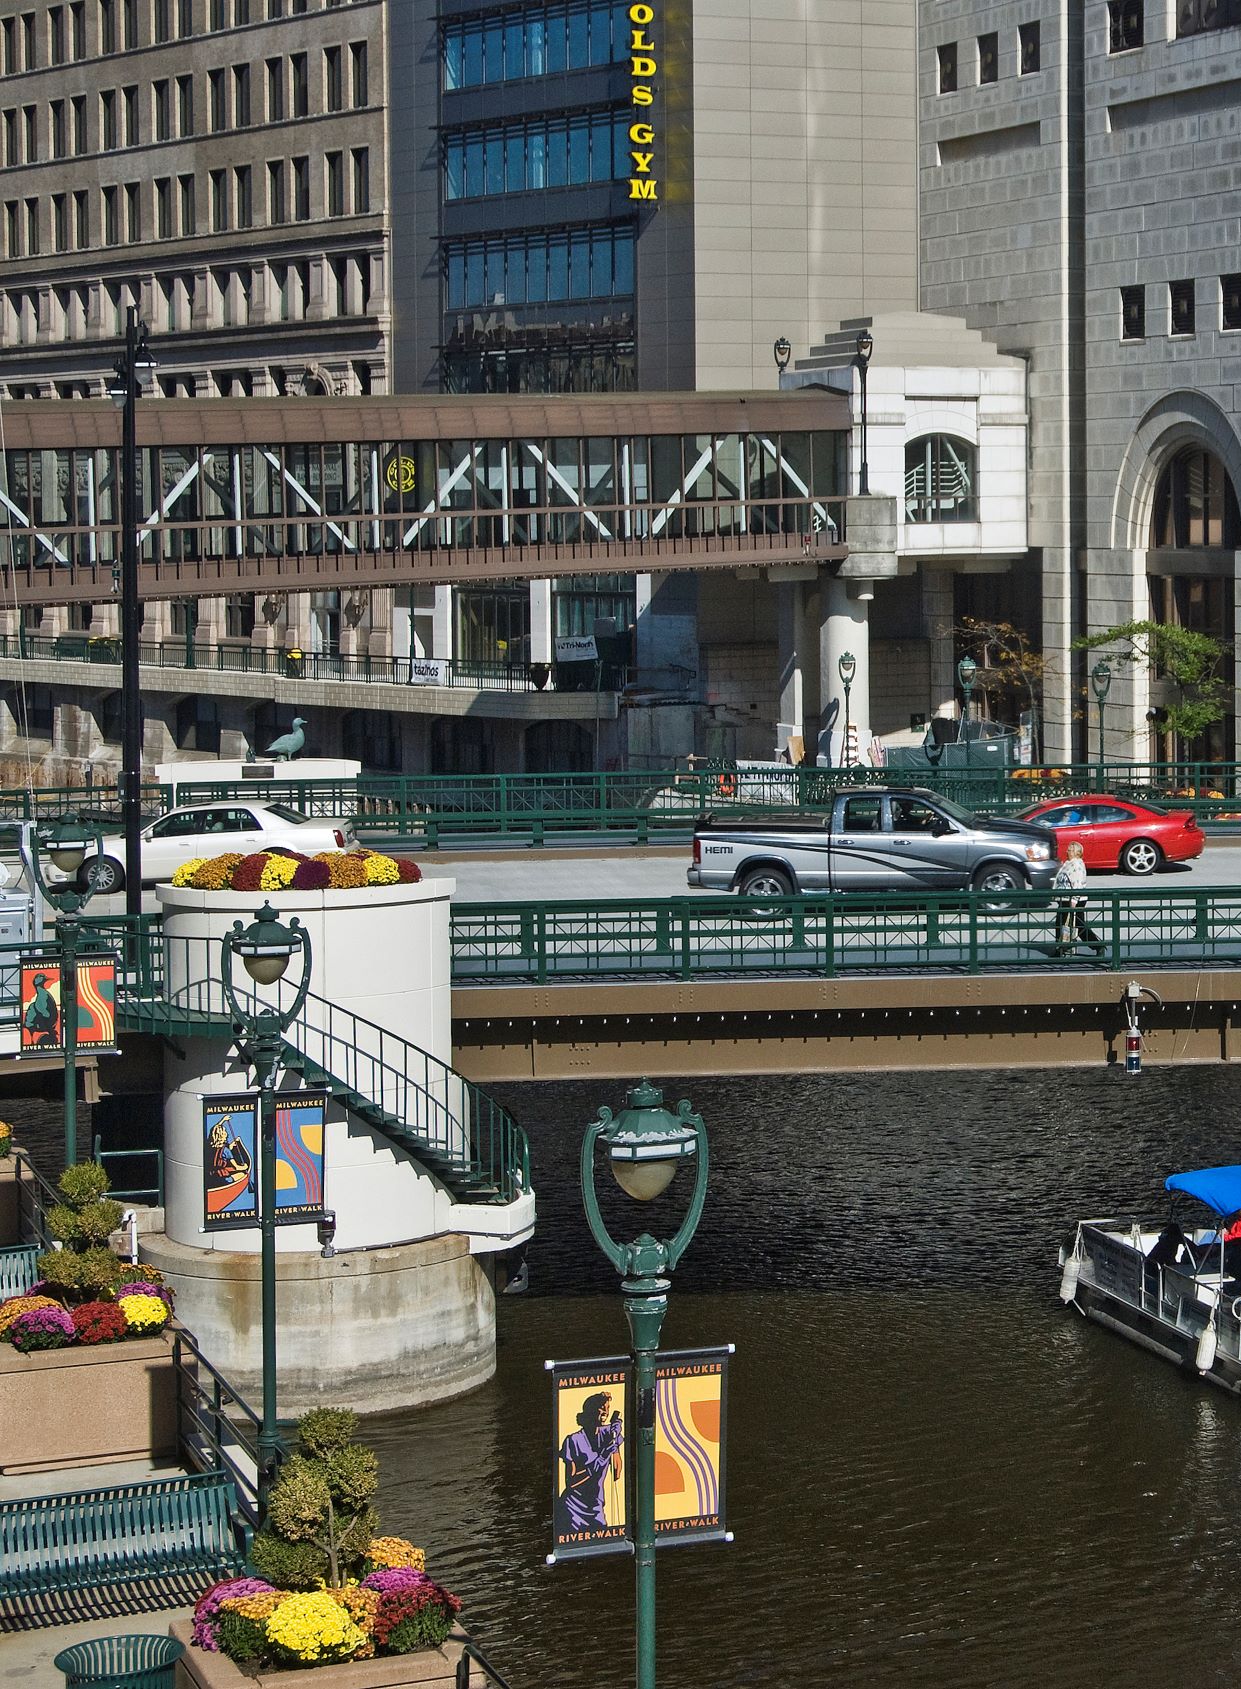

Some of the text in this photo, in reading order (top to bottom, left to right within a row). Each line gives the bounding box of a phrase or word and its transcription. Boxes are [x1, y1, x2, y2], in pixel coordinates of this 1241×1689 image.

[629, 123, 658, 200] GYM
[704, 846, 734, 855] HEMI
[22, 962, 60, 970] MILWAUKEE
[206, 1104, 255, 1113] MILWAUKEE
[276, 1100, 324, 1109] MILWAUKEE
[275, 1207, 298, 1215] RIVER
[656, 1363, 722, 1377] MILWAUKEE
[558, 1372, 626, 1388] MILWAUKEE
[654, 1516, 719, 1532] RIVER WALK
[558, 1527, 626, 1544] RIVER WALK
